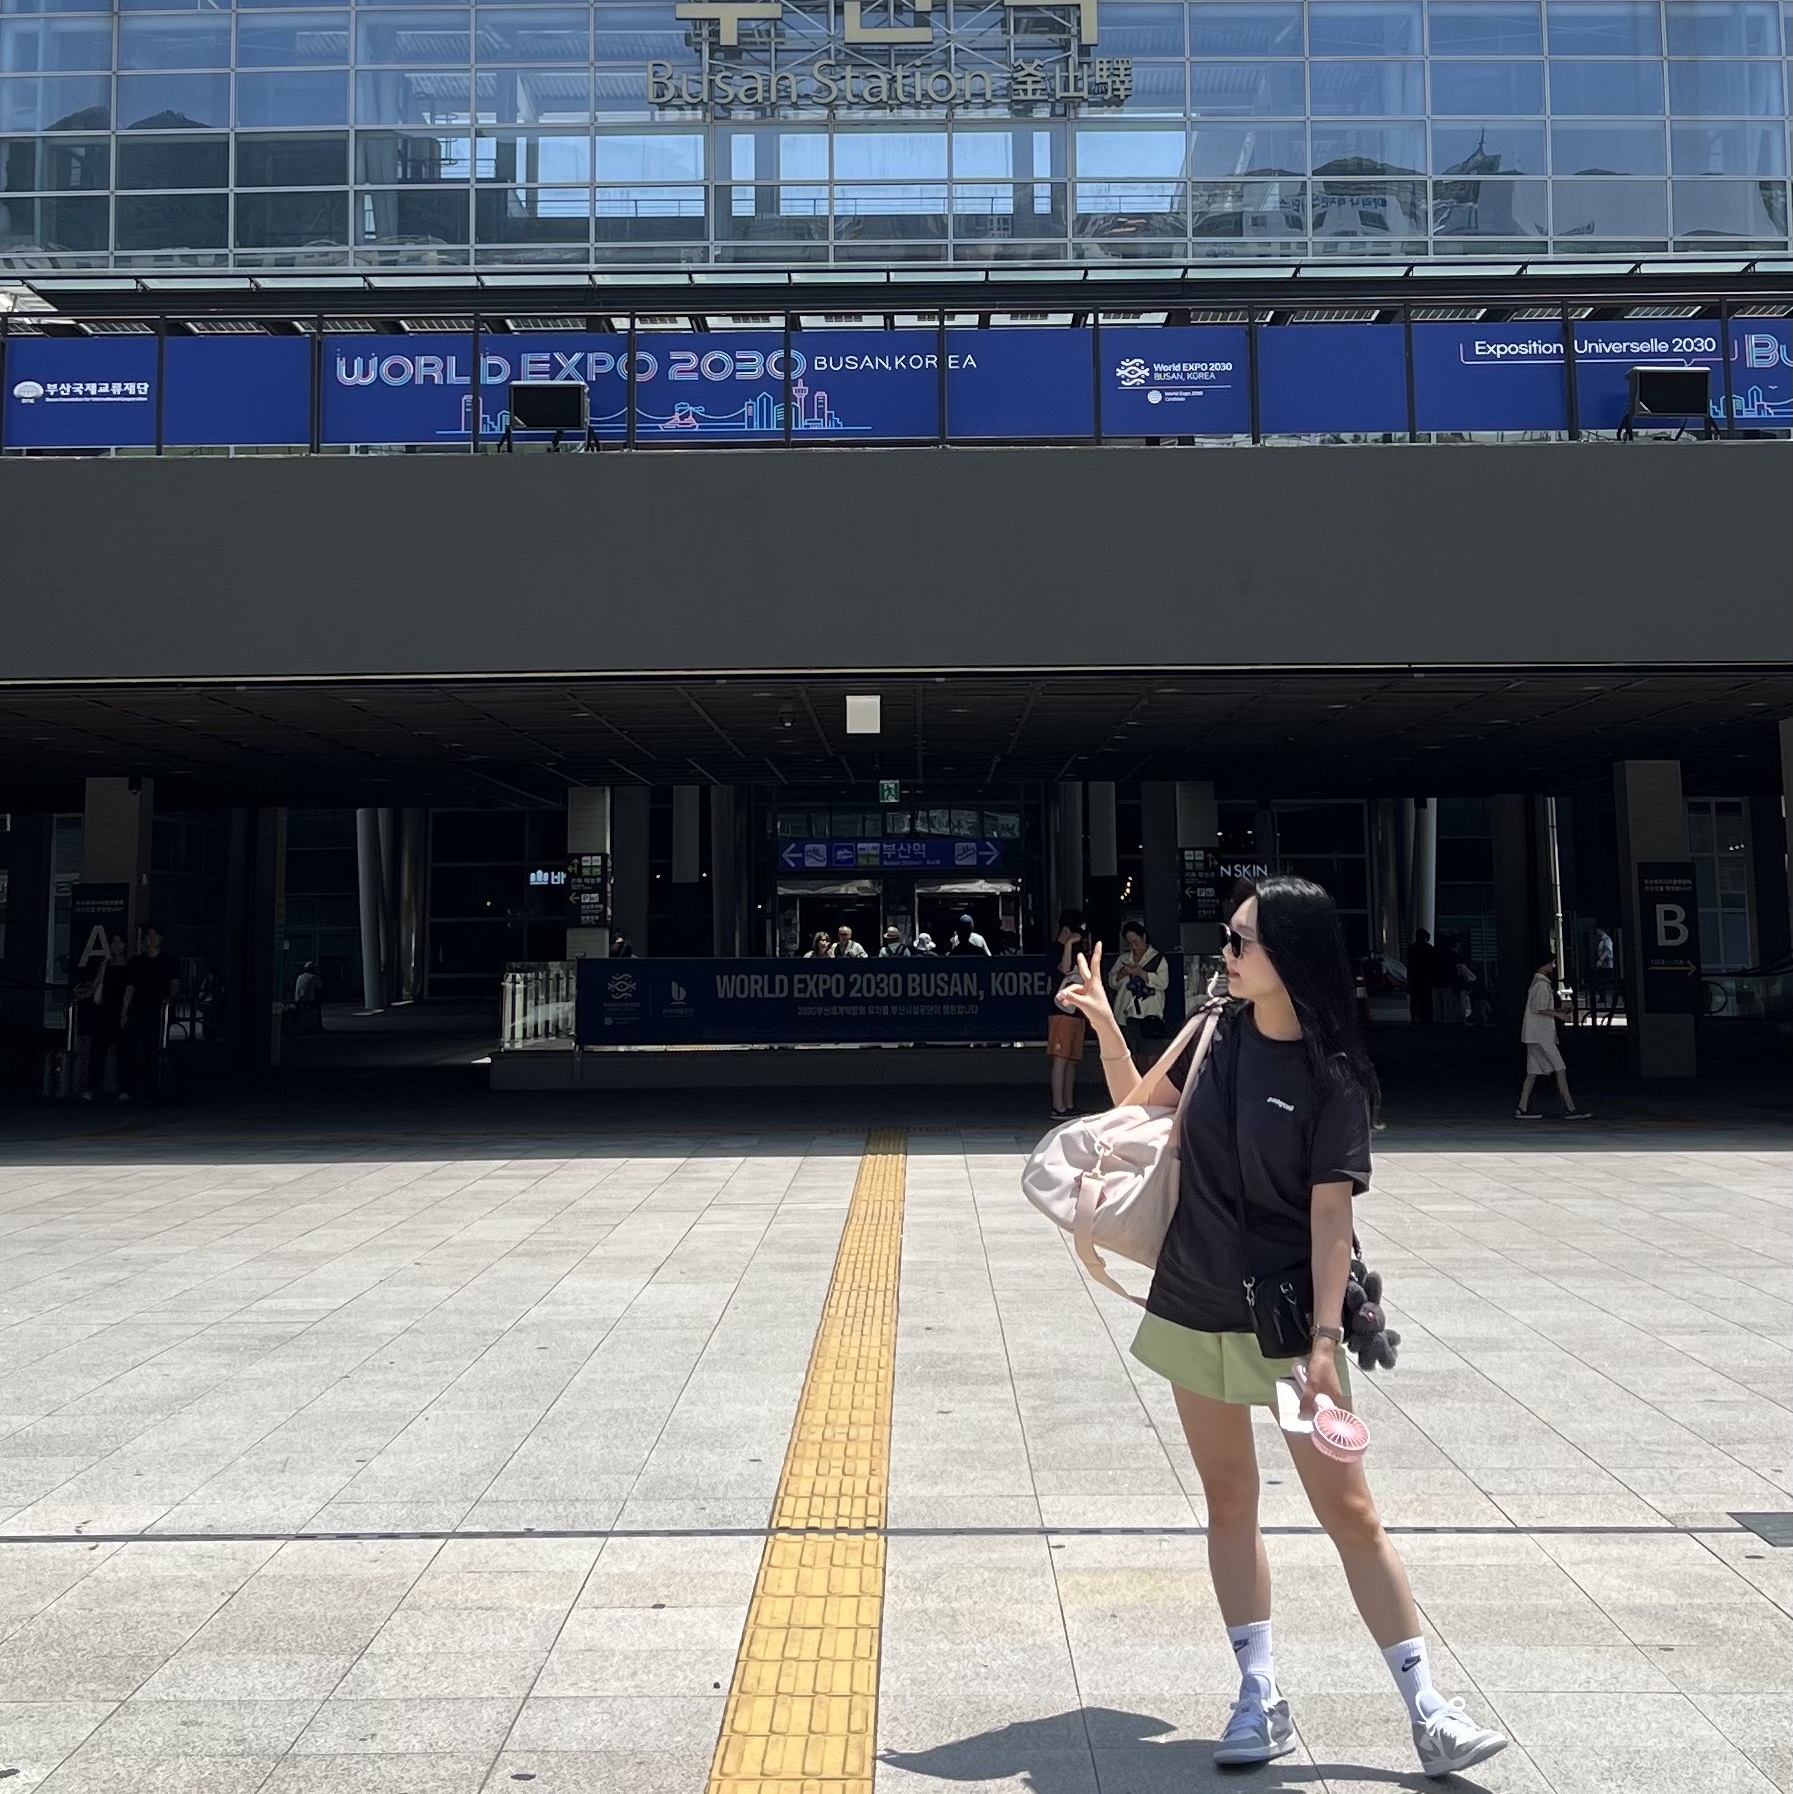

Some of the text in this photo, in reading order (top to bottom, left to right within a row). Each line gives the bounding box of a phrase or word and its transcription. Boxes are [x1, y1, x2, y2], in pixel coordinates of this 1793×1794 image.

[647, 59, 992, 104] Busan Station
[1011, 57, 1133, 102] 釜山驛
[1475, 337, 1717, 358] Exposition Universelle 2030
[335, 349, 808, 387] WORLD EXPO 2030
[1153, 362, 1233, 372] World EXPO 2030
[1154, 372, 1216, 382] BUSAN, KOREA
[45, 382, 150, 396] 부산국제교류재단
[882, 843, 927, 859] 부산역
[1233, 863, 1268, 878] SKIN
[1656, 903, 1690, 947] B
[78, 925, 112, 968] A
[715, 974, 789, 999] WORLD
[793, 974, 845, 998] EXPO
[849, 974, 903, 998] 2030
[907, 973, 985, 1000] BUSAN,
